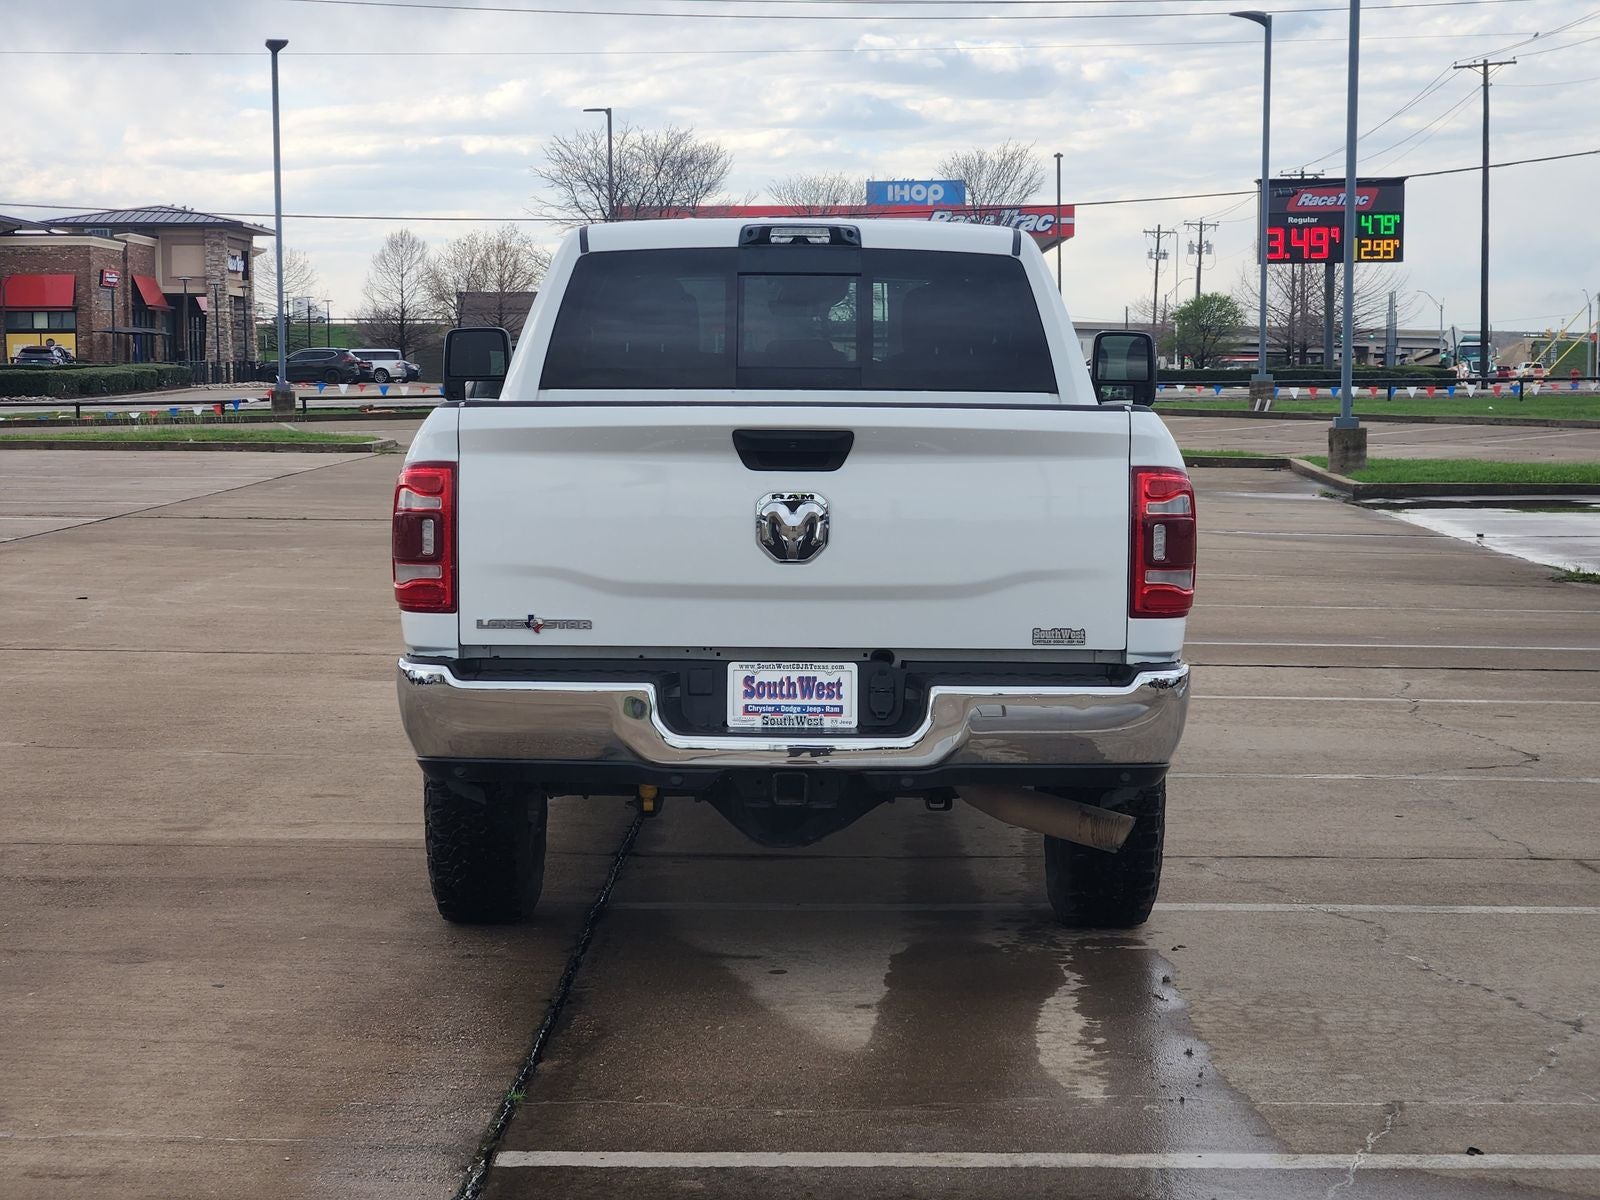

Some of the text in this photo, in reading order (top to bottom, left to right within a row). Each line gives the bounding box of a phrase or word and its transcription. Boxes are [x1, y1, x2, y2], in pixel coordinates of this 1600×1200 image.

[887, 184, 945, 206] IHOP
[1297, 192, 1369, 206] RaceTc
[1287, 216, 1319, 225] Regular
[476, 619, 593, 630] LONE STAR
[1033, 628, 1086, 639] SouthWest
[738, 663, 845, 671] www.SouthWestCDJRTexas.com
[742, 674, 844, 701] SouthWest
[747, 704, 775, 713] Chrysler
[780, 705, 801, 713] Dodge
[806, 705, 821, 714] Jeep
[761, 715, 824, 727] SouthWest
